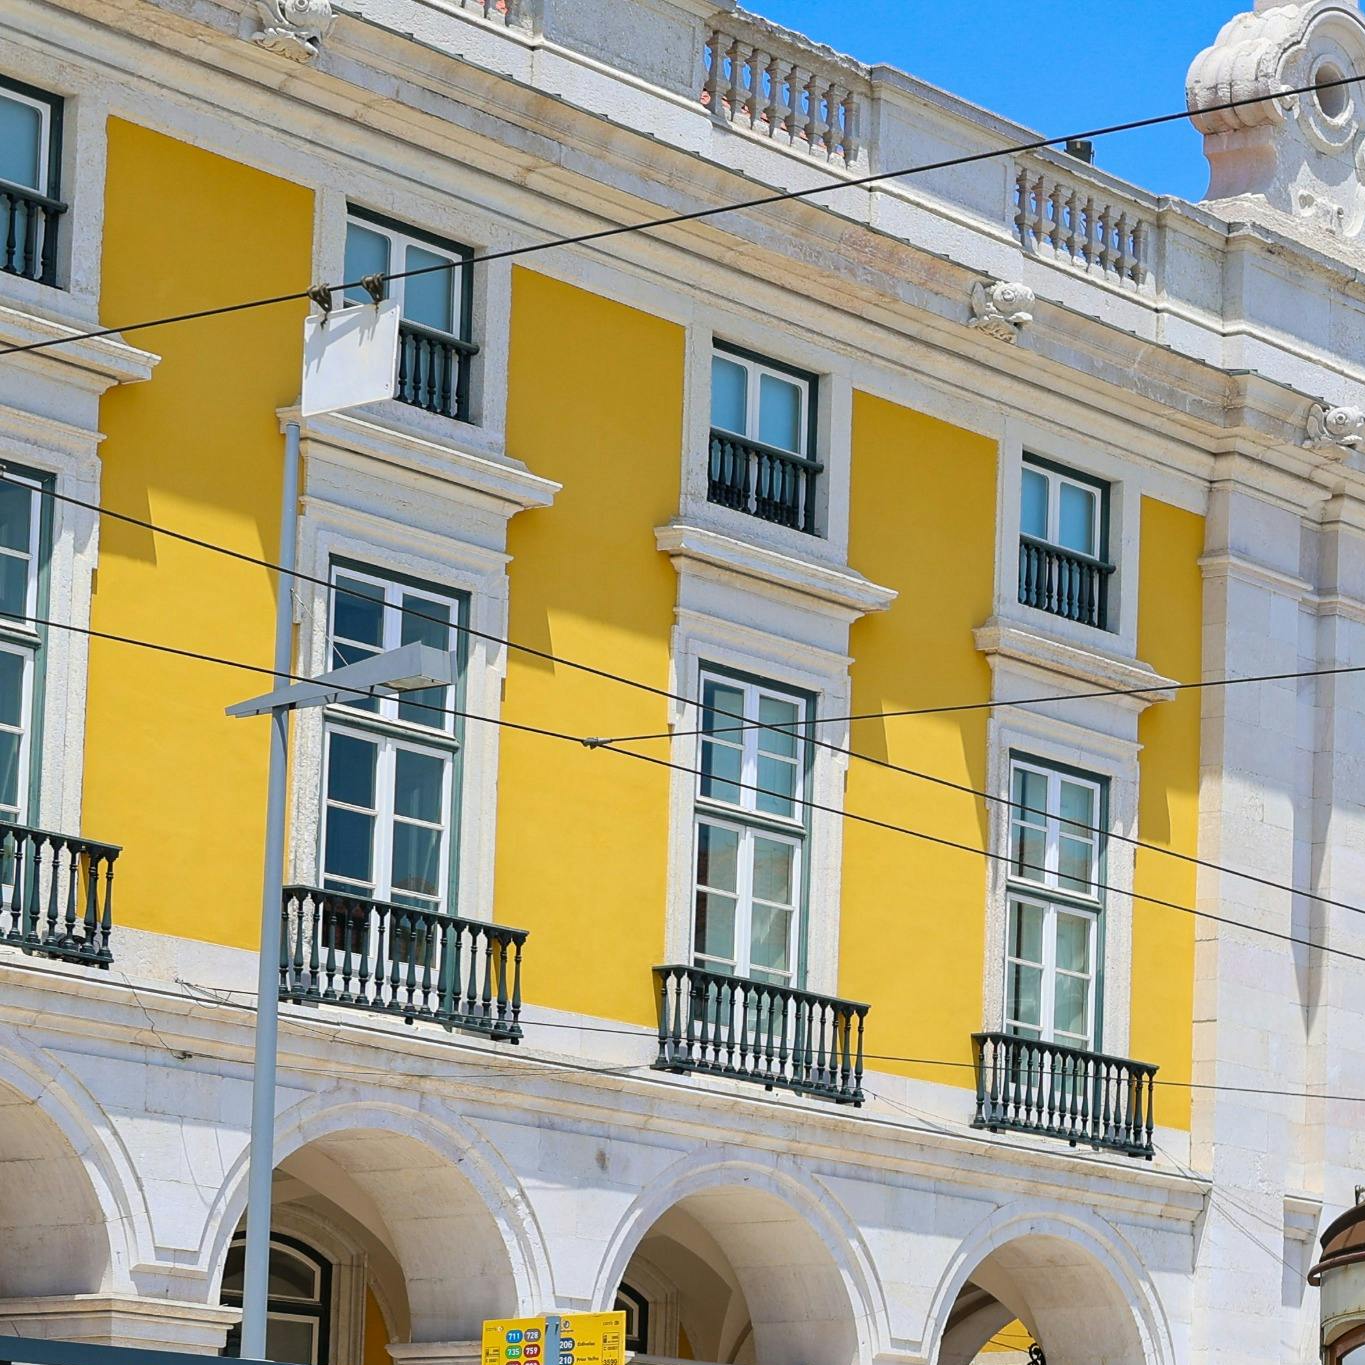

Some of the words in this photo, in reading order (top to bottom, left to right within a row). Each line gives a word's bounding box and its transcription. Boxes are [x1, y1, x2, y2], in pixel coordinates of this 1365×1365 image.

[508, 1332, 520, 1341] 711
[560, 1340, 573, 1349] 206
[507, 1348, 520, 1356] 735
[525, 1347, 538, 1355] 759
[559, 1356, 572, 1365] 210
